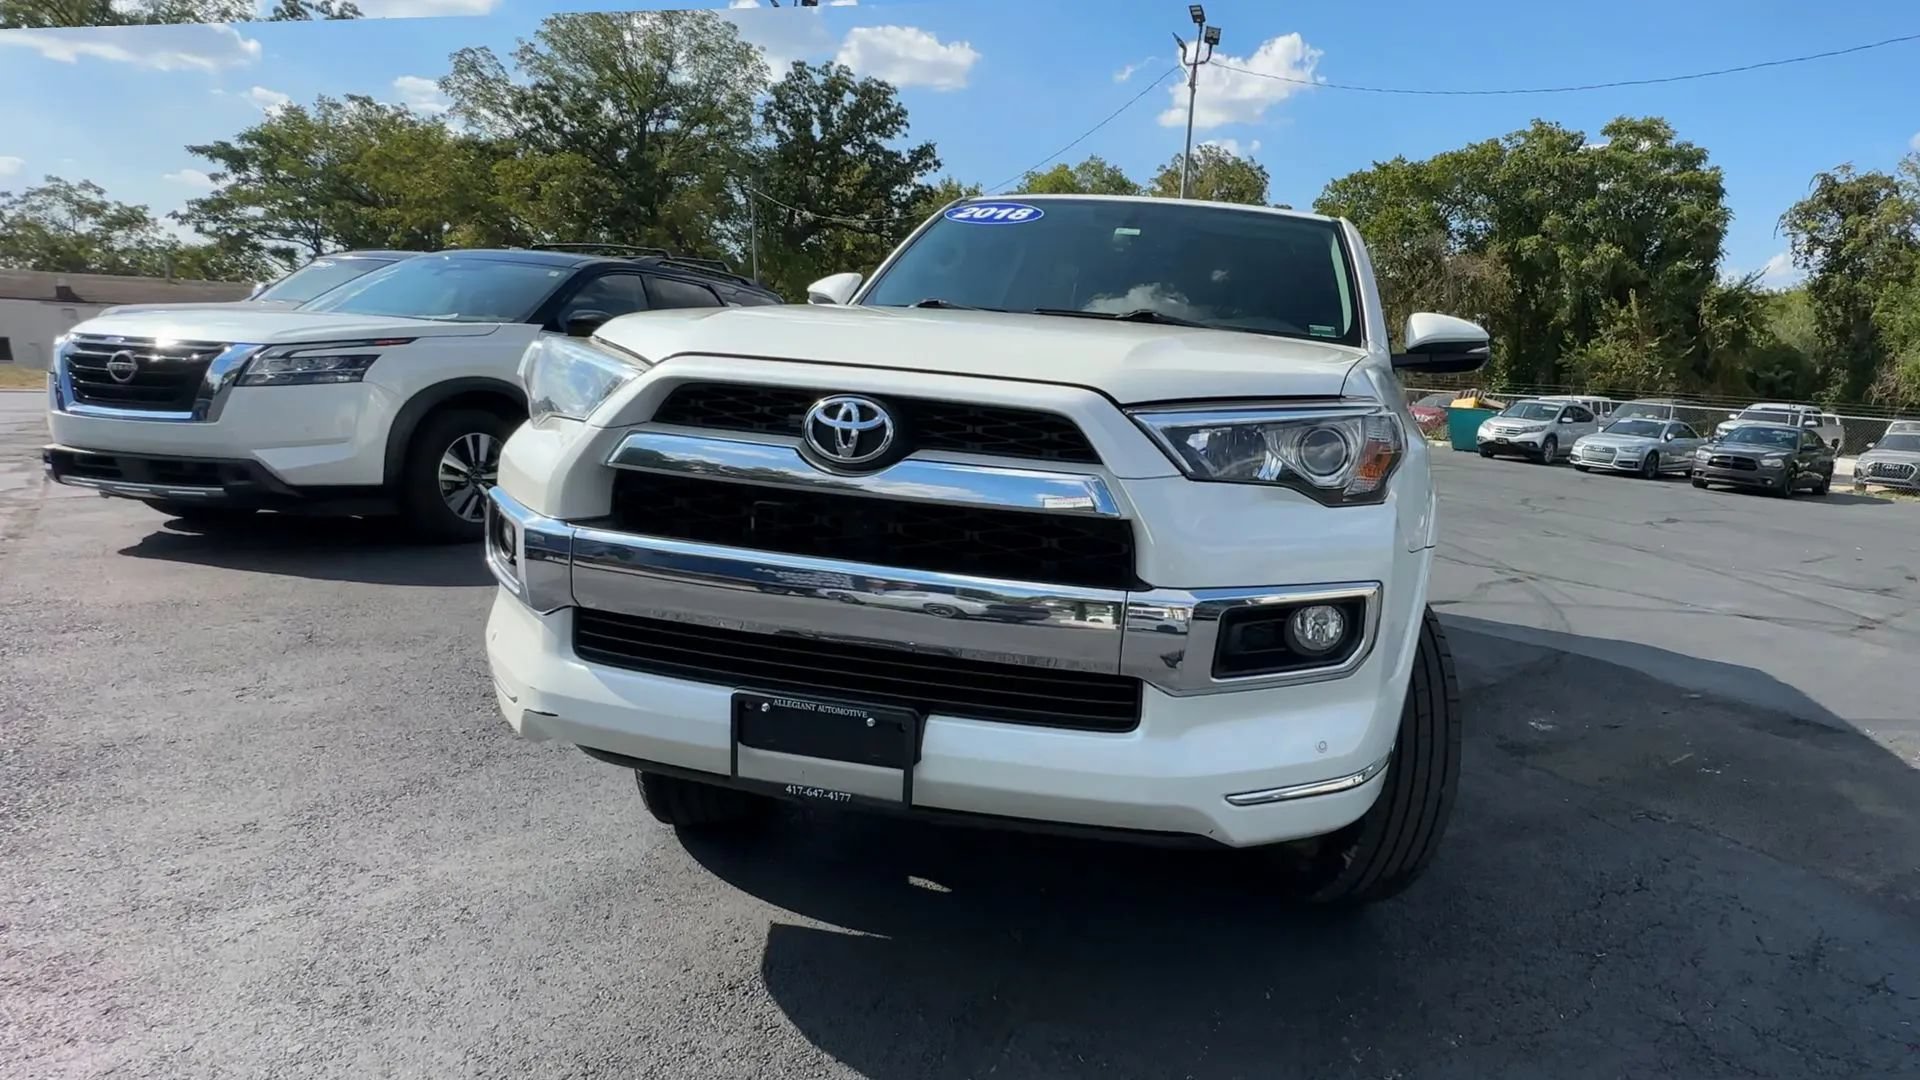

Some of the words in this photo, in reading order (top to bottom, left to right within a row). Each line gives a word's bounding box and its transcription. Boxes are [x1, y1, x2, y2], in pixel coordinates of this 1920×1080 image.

[953, 207, 1034, 220] 2018
[773, 699, 816, 711] ALLEGIANT
[817, 705, 868, 718] AUTOMOTIVE
[785, 785, 851, 802] 417-647-4177
